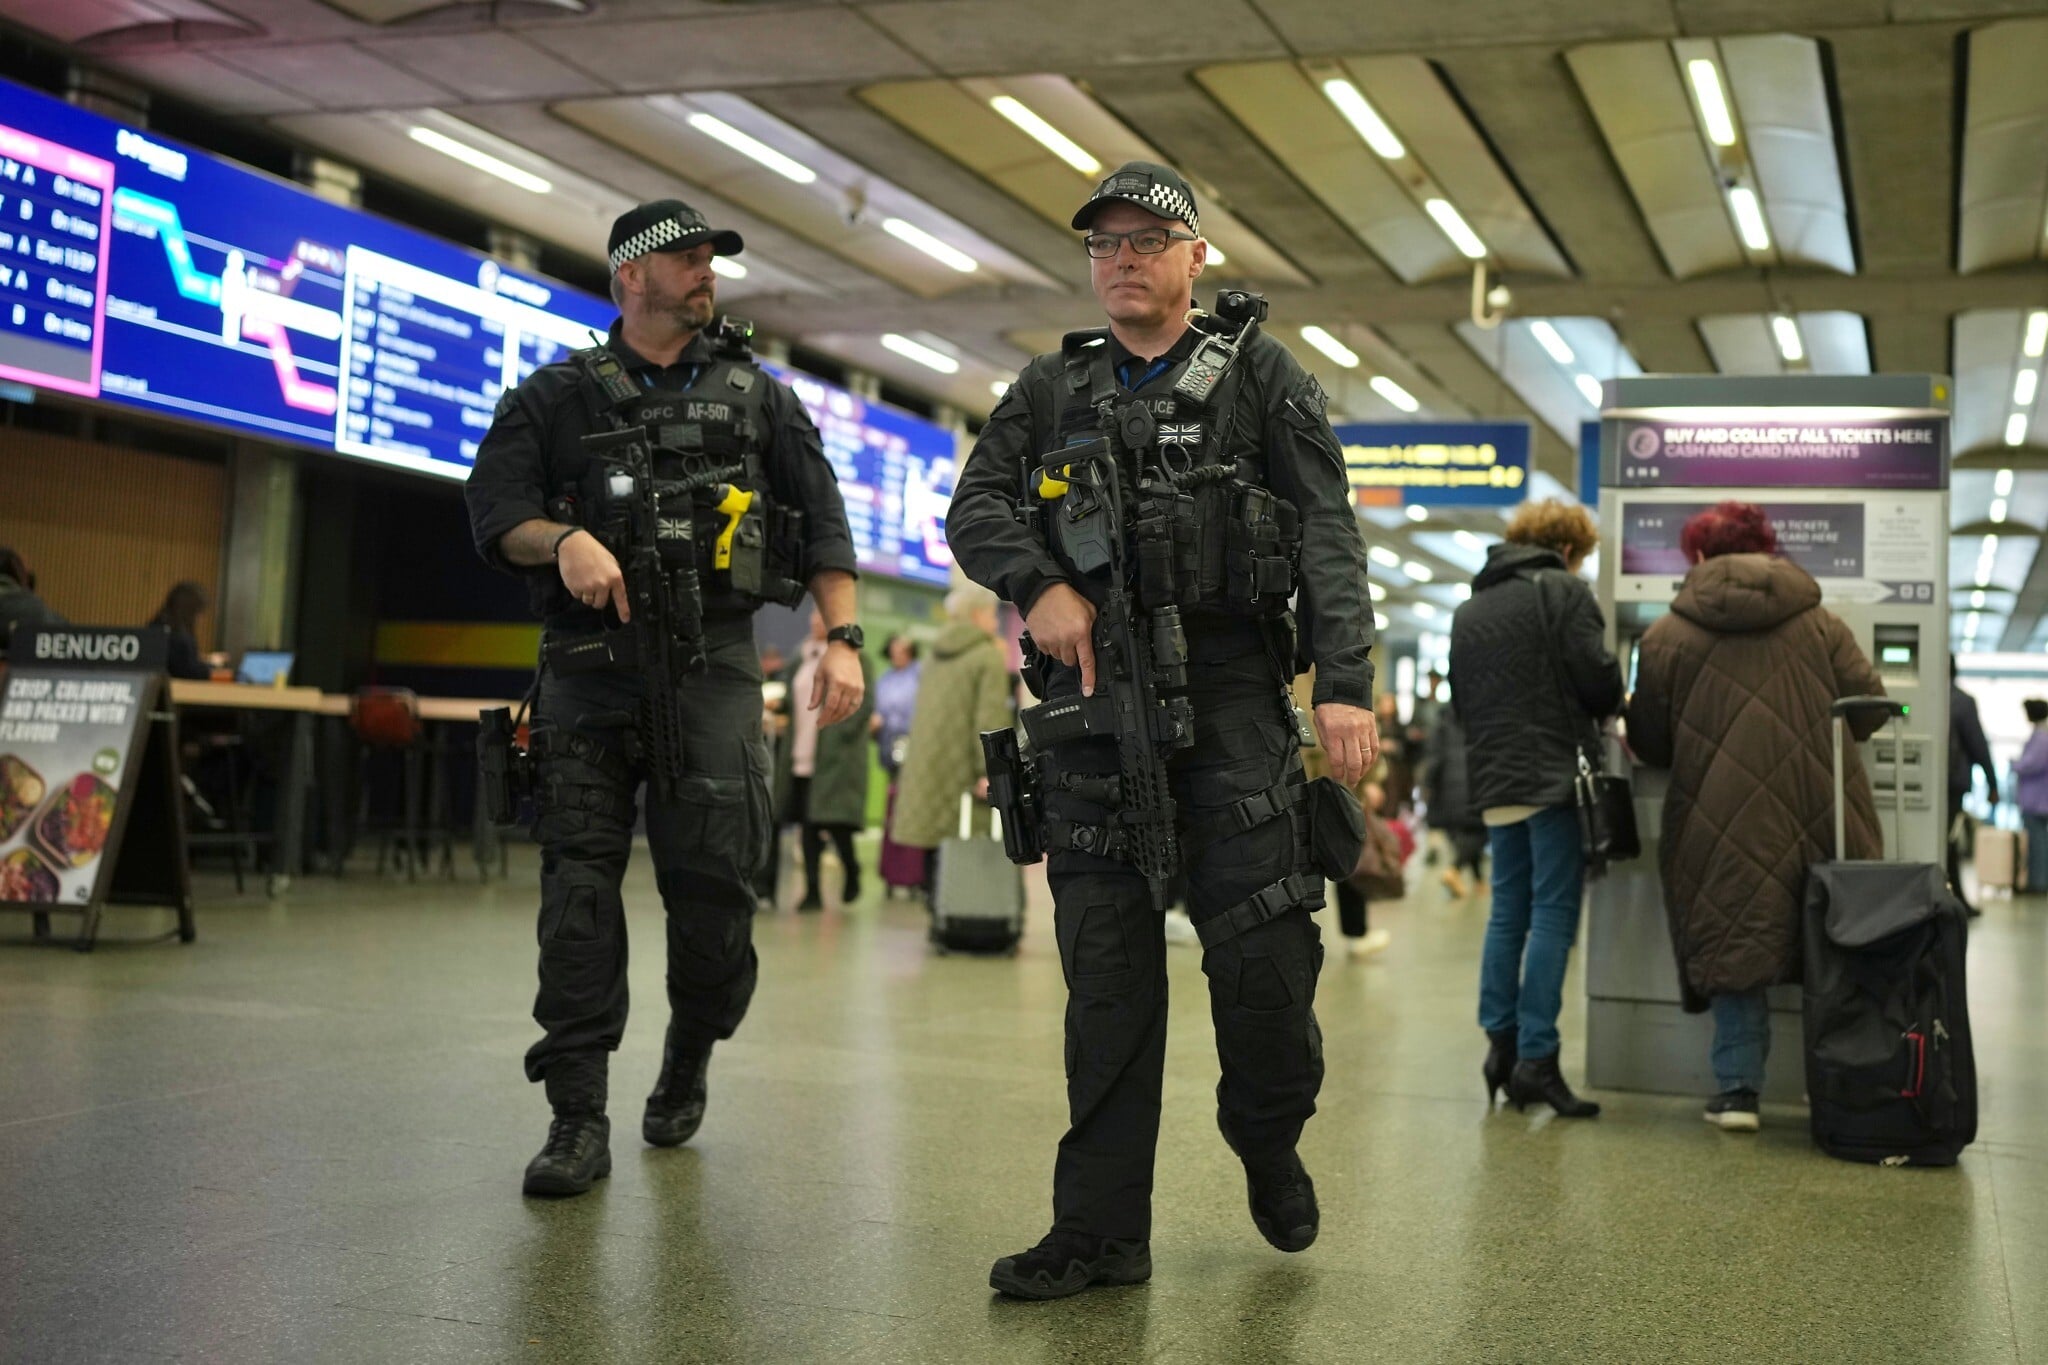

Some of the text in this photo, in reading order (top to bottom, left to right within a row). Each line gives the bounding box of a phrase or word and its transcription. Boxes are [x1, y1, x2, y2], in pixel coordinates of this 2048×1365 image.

[687, 402, 729, 421] AF-507
[1664, 428, 1934, 444] BUY AND COLLECT ALL TICKETS HERE
[1664, 444, 1860, 458] CASH AND CARD PAYMENTS
[36, 633, 139, 661] BENUGO
[3, 700, 34, 719] AND
